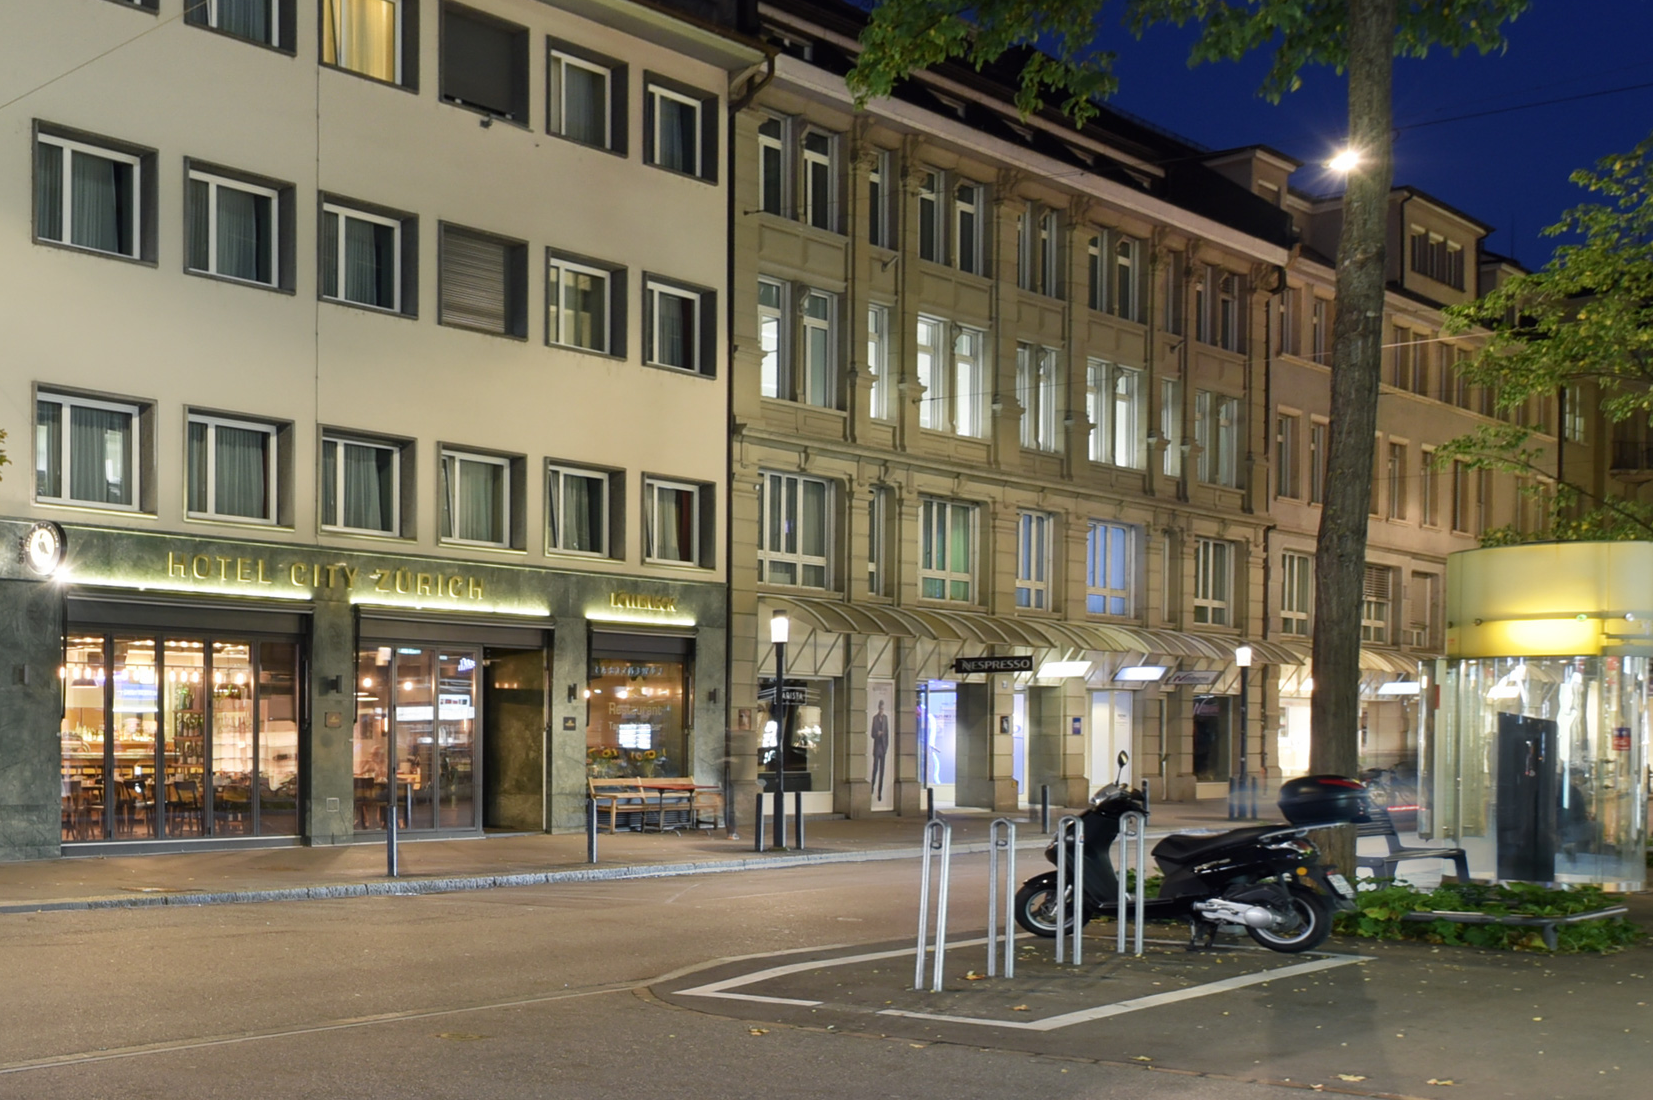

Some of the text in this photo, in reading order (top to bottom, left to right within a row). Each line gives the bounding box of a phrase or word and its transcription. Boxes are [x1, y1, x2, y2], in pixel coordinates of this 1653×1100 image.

[167, 551, 484, 599] HOTEL CITY ZÜRICH
[961, 660, 1030, 671] NESPRESSO
[782, 691, 803, 700] ARISTA
[609, 702, 663, 716] Restaurant
